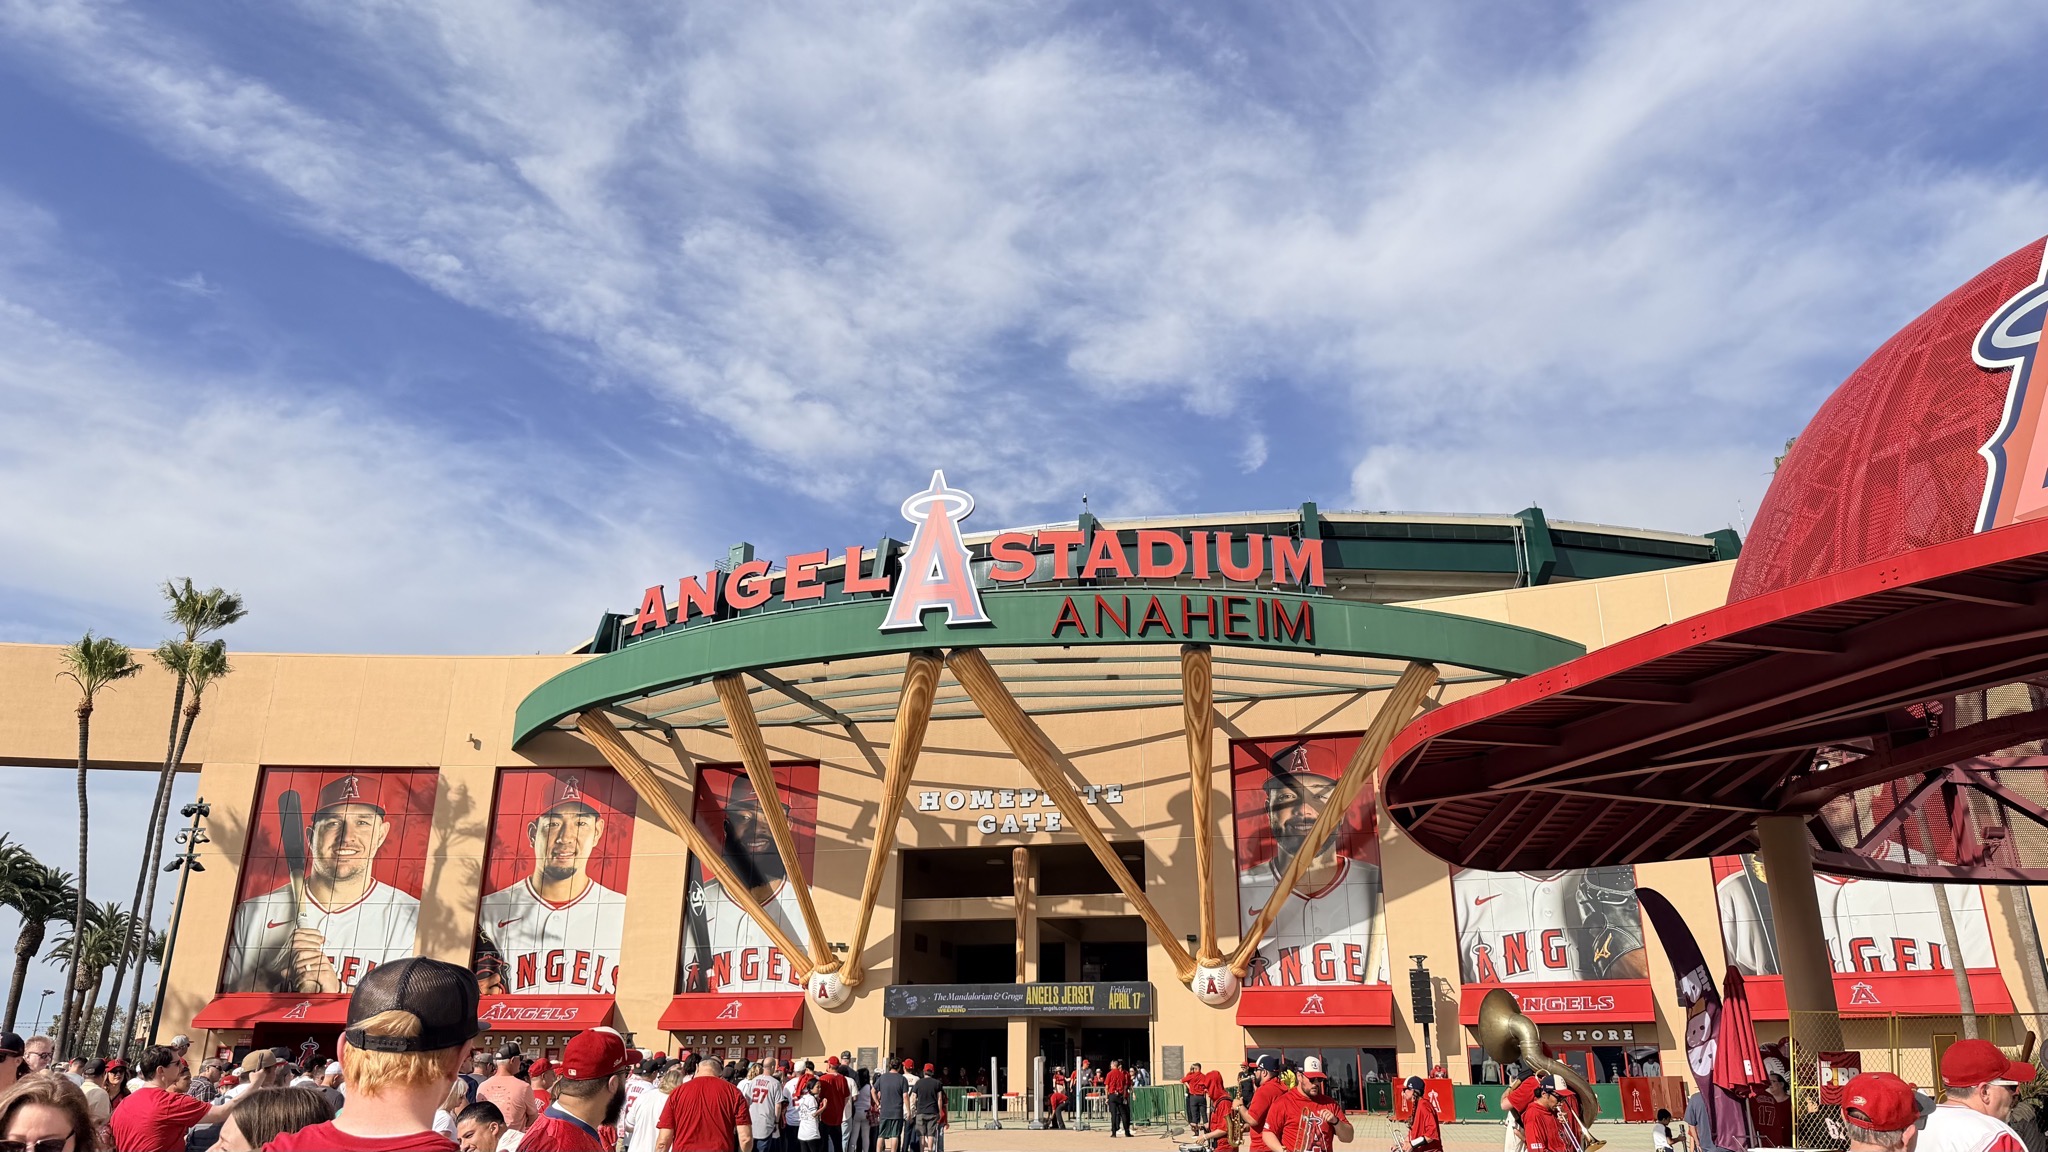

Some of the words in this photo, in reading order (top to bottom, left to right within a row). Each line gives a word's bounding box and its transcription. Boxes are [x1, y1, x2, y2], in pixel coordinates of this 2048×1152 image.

[632, 545, 891, 636] ANGEL
[988, 528, 1326, 588] STADIUM
[1051, 594, 1313, 642] ANAHEIM
[918, 783, 1123, 811] HOMEPLTE
[977, 812, 1062, 834] GATE
[933, 992, 946, 1001] The
[947, 991, 992, 1001] Mandalorian
[993, 992, 1001, 1001] &
[1001, 991, 1024, 1002] Grogu
[1026, 986, 1059, 1005] ANGELS
[1061, 985, 1095, 1005] JERSEY
[1110, 985, 1132, 994] Friday
[1109, 992, 1131, 1009] APRIL
[1519, 995, 1615, 1012] NGELS
[479, 1002, 578, 1020] ANGELS
[485, 1035, 570, 1046] TICKET
[686, 1034, 787, 1045] TICKETS
[1562, 1029, 1634, 1042] STORE
[752, 1088, 769, 1104] 27
[1758, 1105, 1775, 1126] 17
